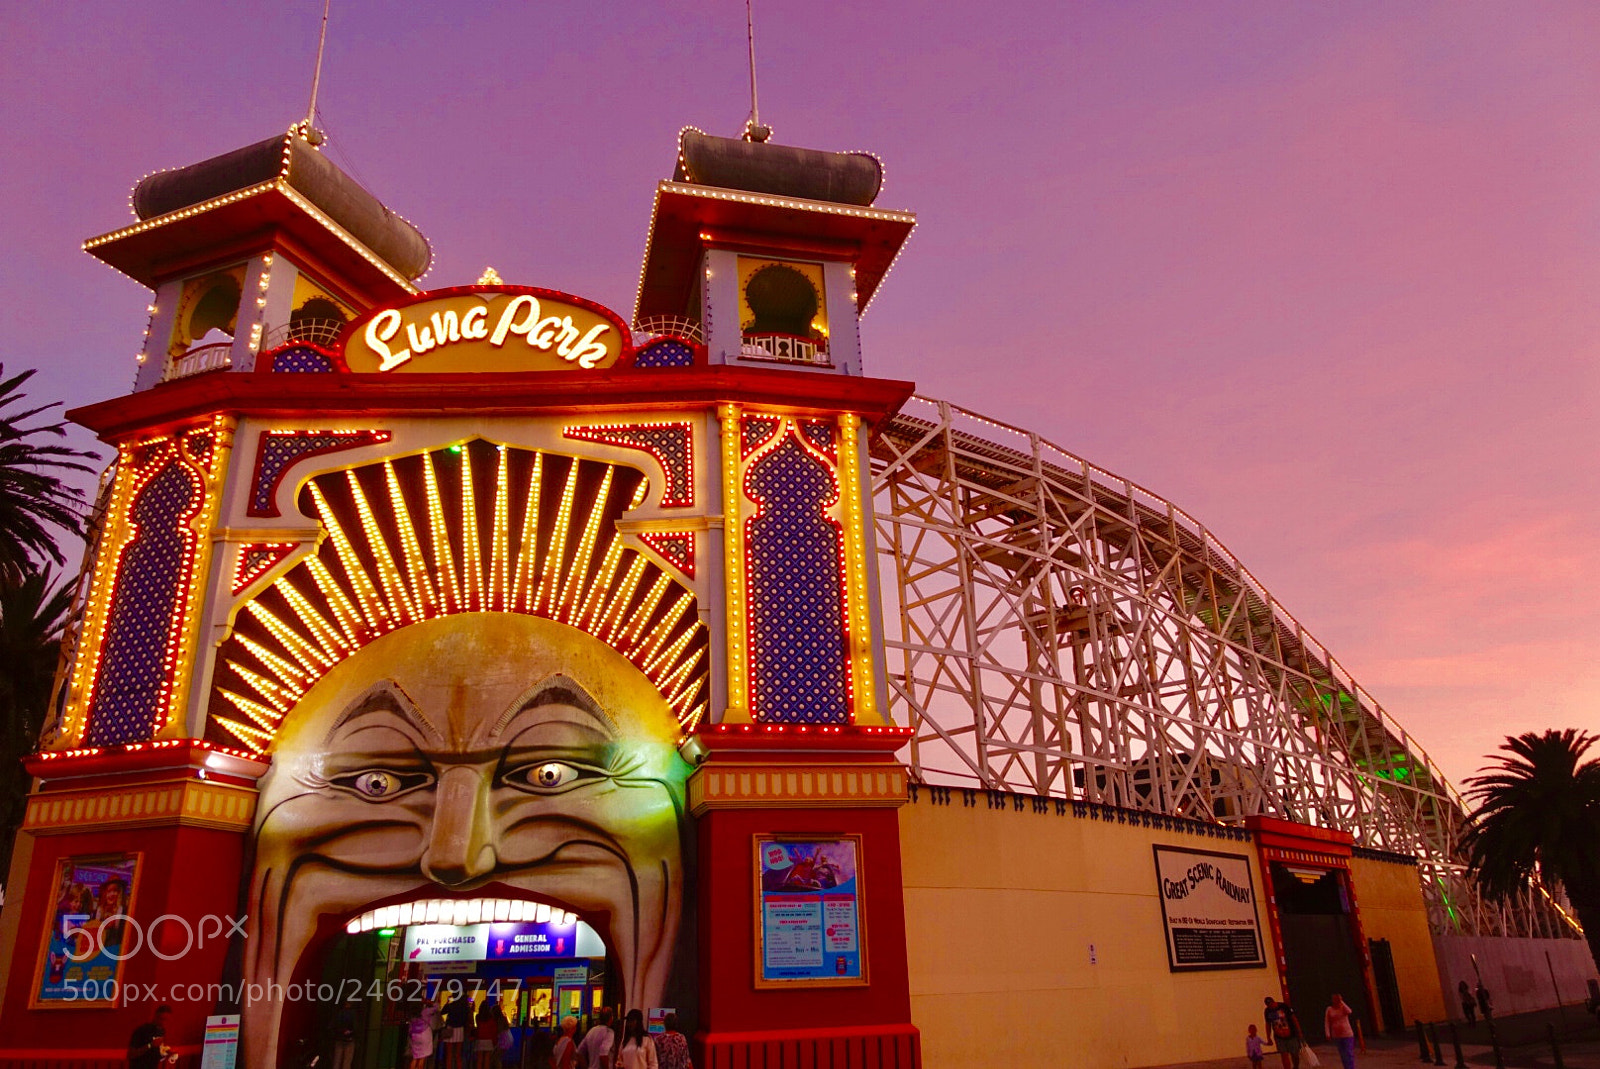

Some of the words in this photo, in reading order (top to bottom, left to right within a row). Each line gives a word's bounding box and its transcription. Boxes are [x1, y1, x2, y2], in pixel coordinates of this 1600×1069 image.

[365, 306, 488, 371] Luna
[490, 294, 610, 369] Park
[1163, 878, 1190, 900] GREAT
[1187, 862, 1214, 890] SCENIC
[1215, 867, 1250, 904] RAILWAY
[514, 934, 548, 943] GENERAL
[430, 946, 460, 955] TICKETS
[509, 944, 551, 954] ADMISSION
